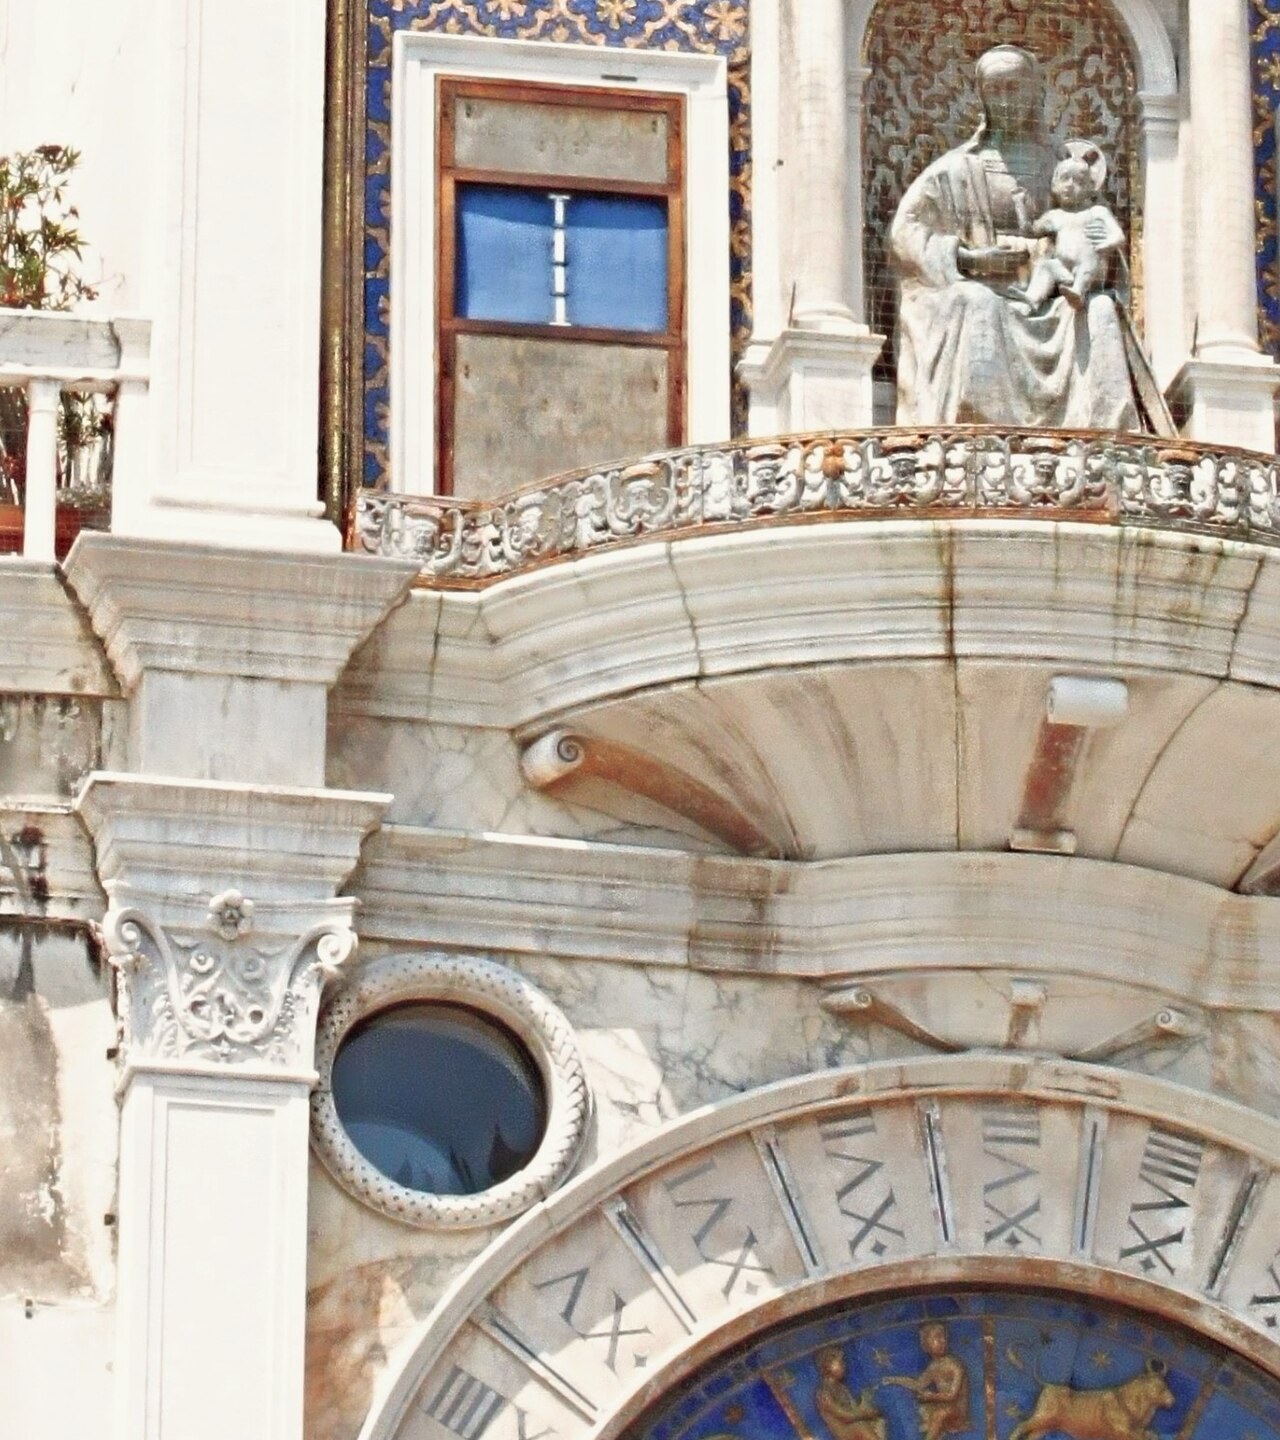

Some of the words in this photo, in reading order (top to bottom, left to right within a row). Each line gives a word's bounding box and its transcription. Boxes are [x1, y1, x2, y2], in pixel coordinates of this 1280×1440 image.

[664, 1158, 775, 1301] XVI
[817, 1108, 905, 1255] XVII
[533, 1268, 654, 1373] XV
